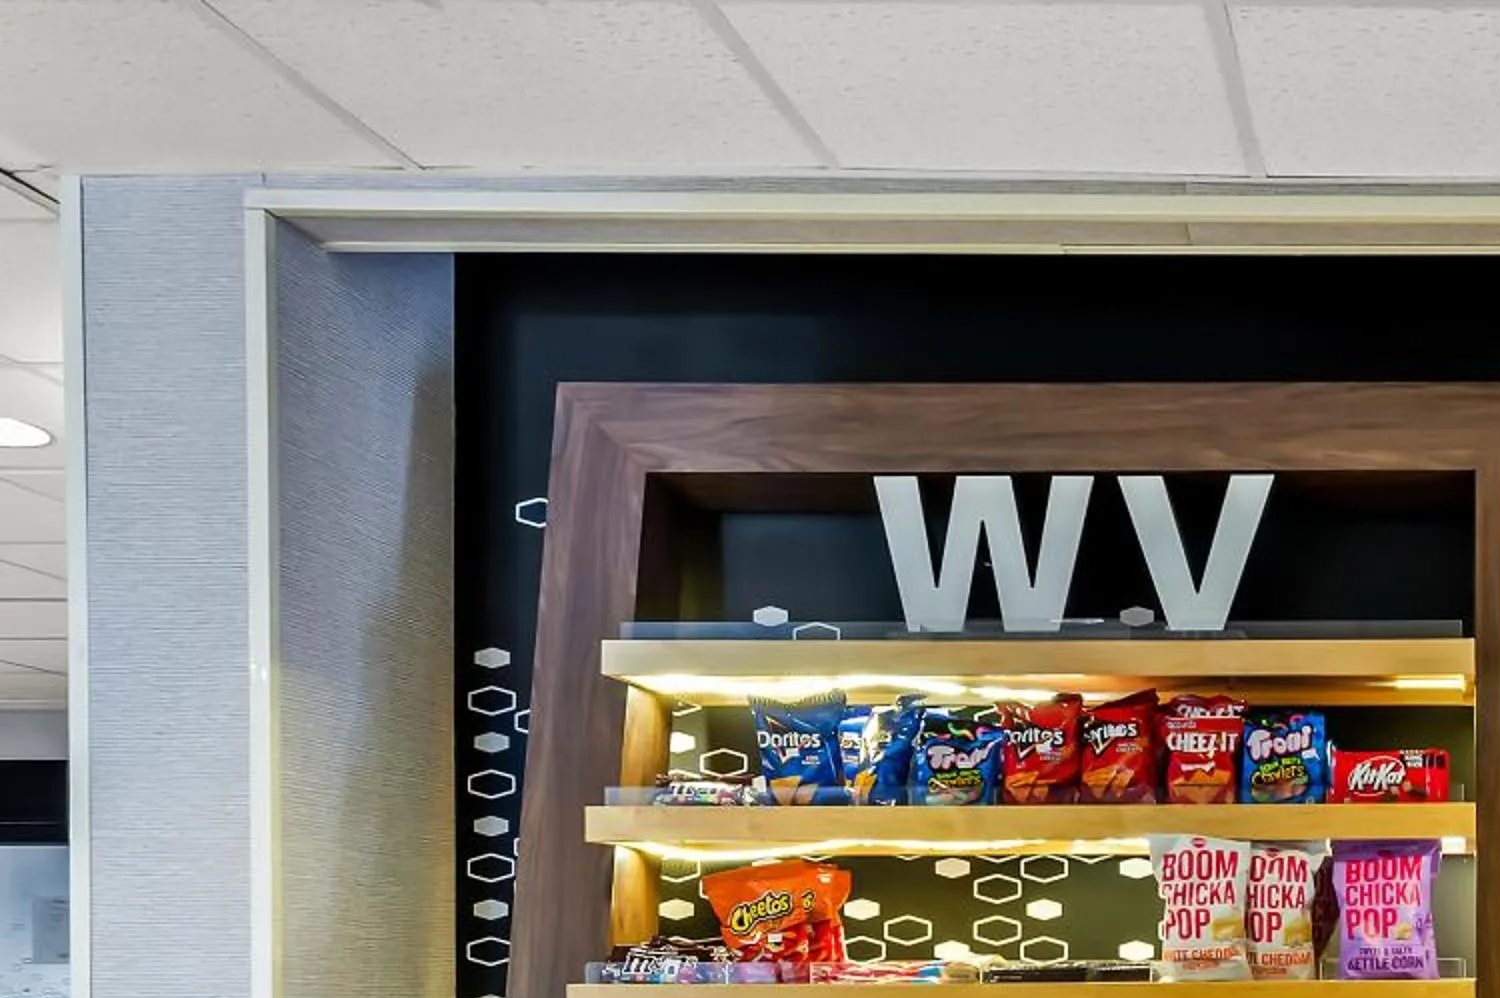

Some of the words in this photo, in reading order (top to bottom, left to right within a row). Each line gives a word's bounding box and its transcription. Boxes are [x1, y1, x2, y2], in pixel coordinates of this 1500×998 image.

[757, 730, 821, 749] Doritos
[1162, 849, 1239, 881] BOOM
[1345, 855, 1422, 883] BOOM
[1249, 885, 1306, 909] HICKA
[1345, 882, 1421, 907] CHICKA
[730, 891, 792, 934] Cheetos
[1164, 907, 1211, 940] POP
[1251, 911, 1283, 943] OP
[1346, 908, 1398, 940] POP
